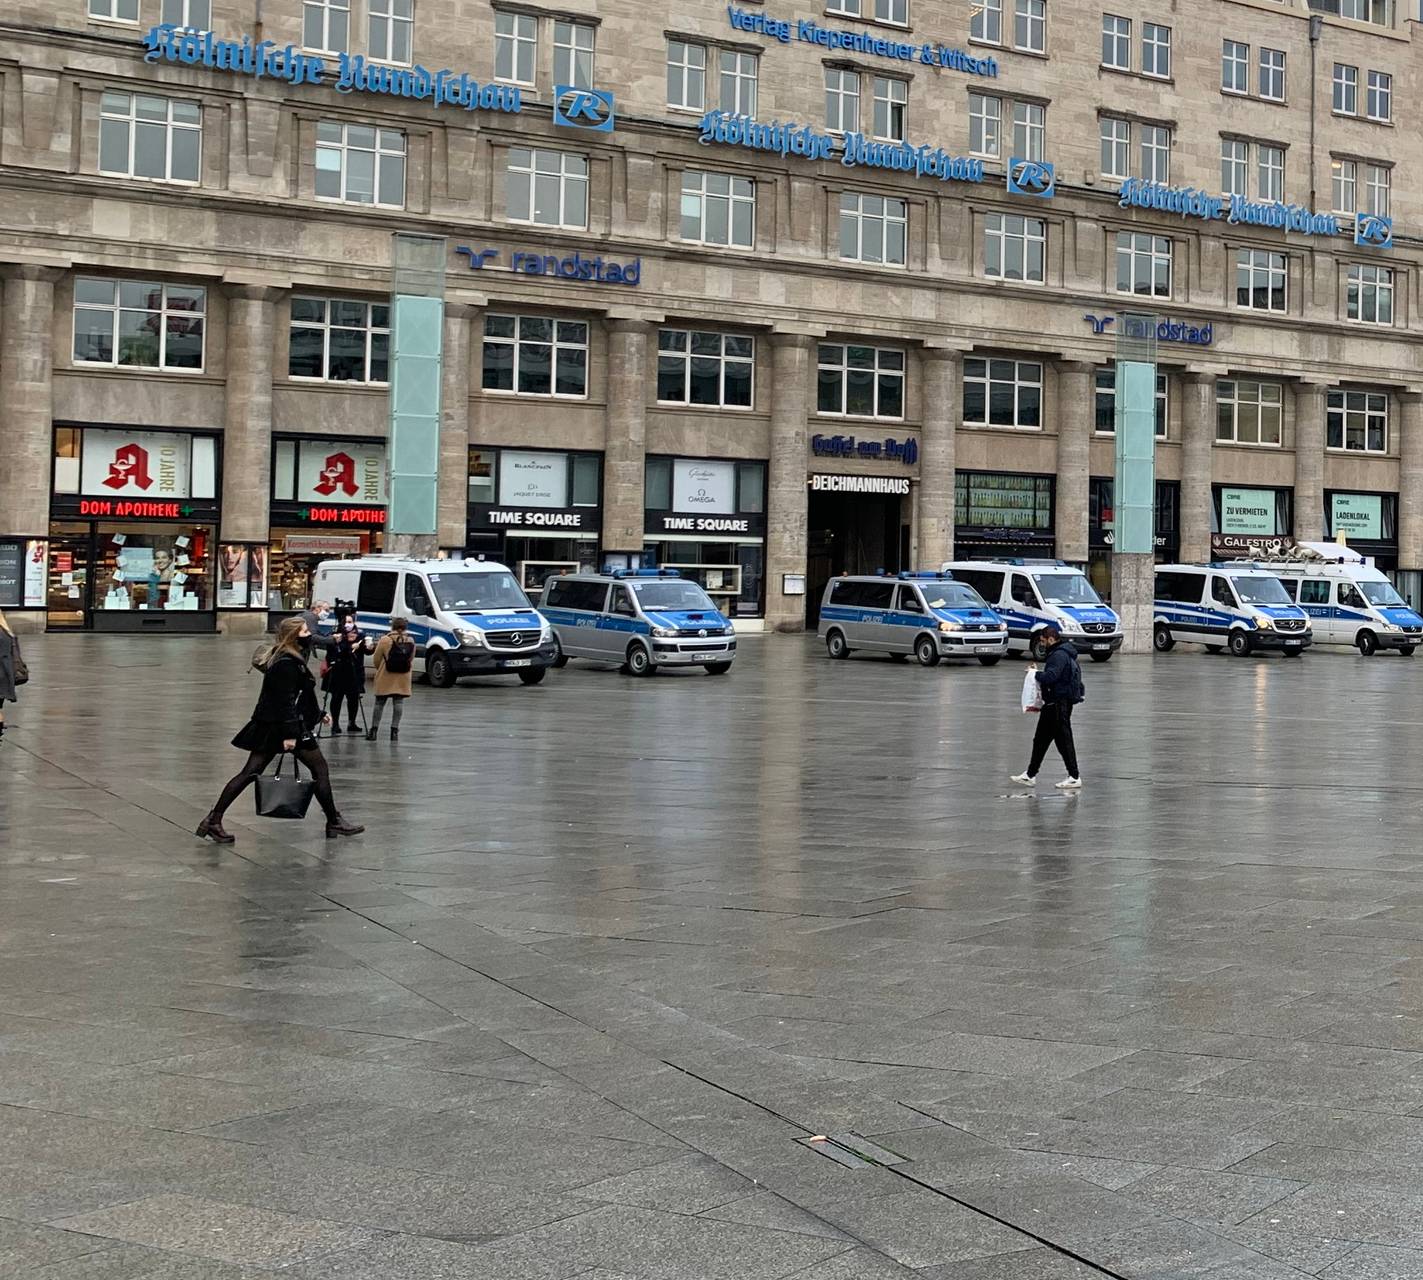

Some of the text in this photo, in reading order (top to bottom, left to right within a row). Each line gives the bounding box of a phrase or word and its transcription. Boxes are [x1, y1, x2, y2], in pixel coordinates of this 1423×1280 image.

[728, 6, 998, 78] Verlag Kiepenheuer & Witsch
[143, 24, 521, 114] Kölnische Rundschau
[699, 109, 985, 182] Kölnische Rundschau
[1119, 176, 1338, 235] Kölnische Rundschau
[512, 250, 641, 286] randstad
[1124, 315, 1213, 346] randstad
[159, 459, 176, 493] JAHRE
[364, 469, 378, 501] JAHRE
[812, 475, 910, 495] DEICHMANNHAUS
[687, 496, 716, 504] OMEGA
[80, 501, 180, 518] DOM APOTHEKE
[310, 508, 338, 522] DOM
[1226, 507, 1268, 517] ZU VERMIETEN
[1336, 512, 1370, 521] LADENLOKAL
[488, 511, 582, 527] TIME SQUARE
[663, 517, 749, 532] TIME SQUARE
[1223, 537, 1283, 549] GALESTRO
[487, 617, 530, 625] POLIZEI
[861, 614, 883, 625] POLIZEI
[1180, 615, 1198, 623] POLIZEI
